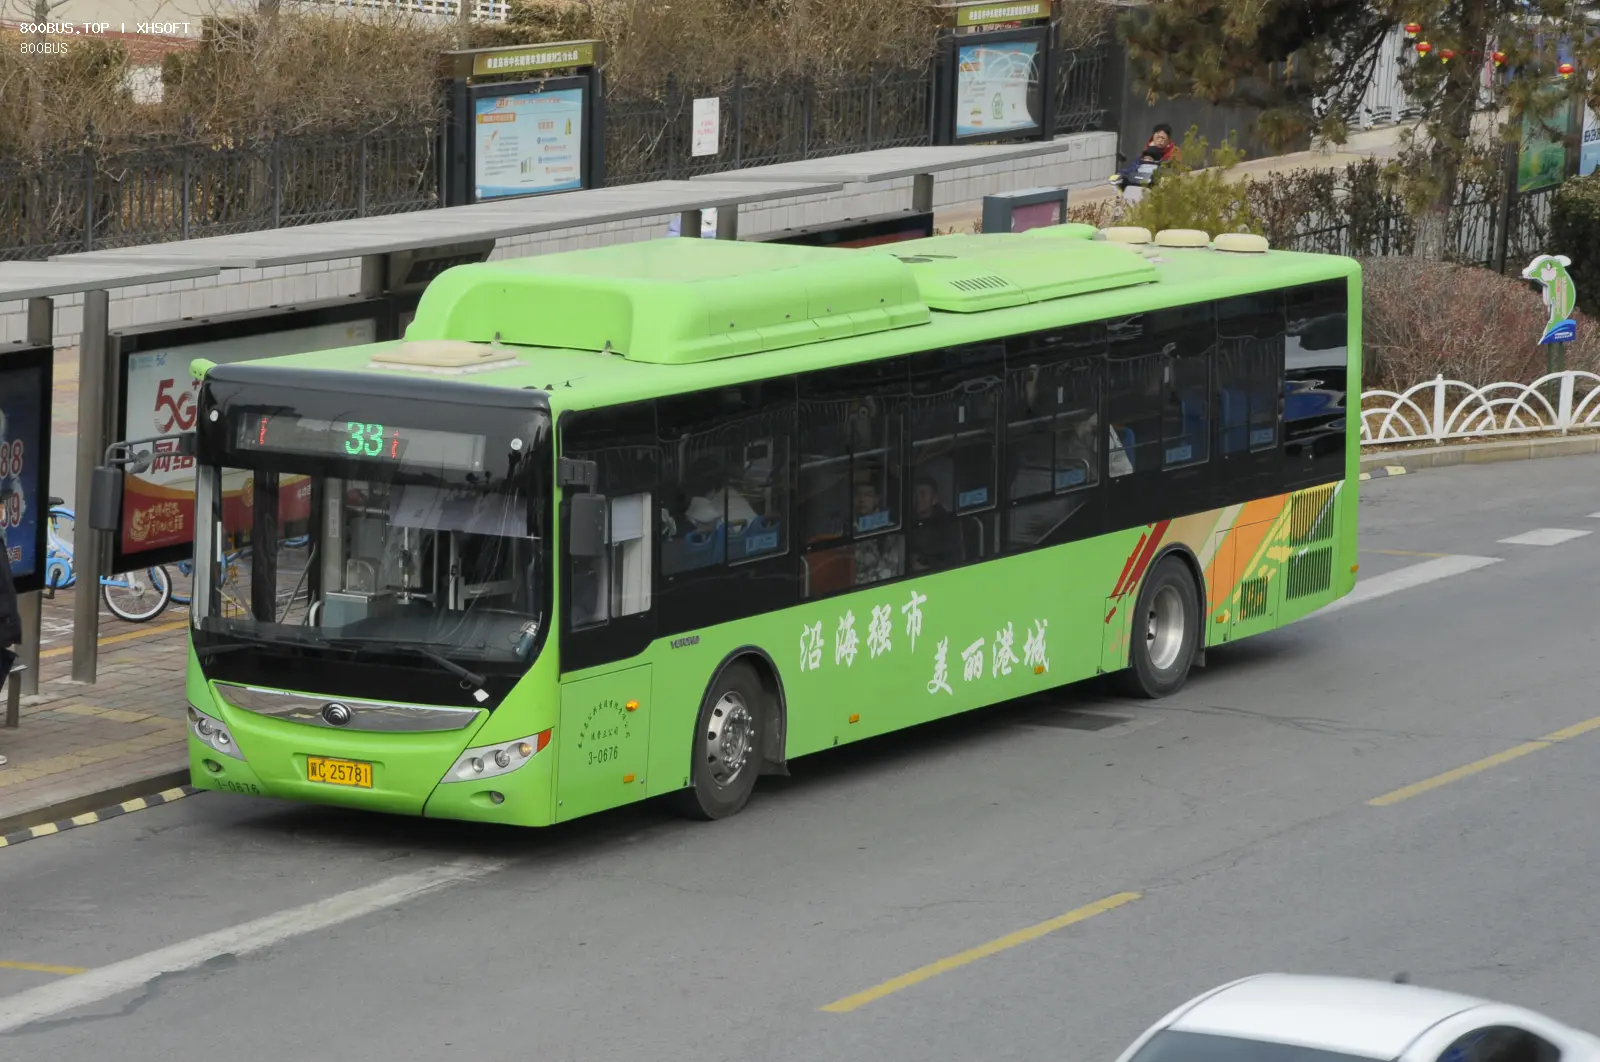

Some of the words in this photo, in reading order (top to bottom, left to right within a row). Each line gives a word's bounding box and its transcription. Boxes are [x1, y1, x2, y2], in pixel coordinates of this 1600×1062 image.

[345, 422, 384, 456] 33
[799, 590, 928, 672] 沿海强市
[926, 618, 1050, 695] 美丽港城
[588, 745, 619, 765] 3-0676
